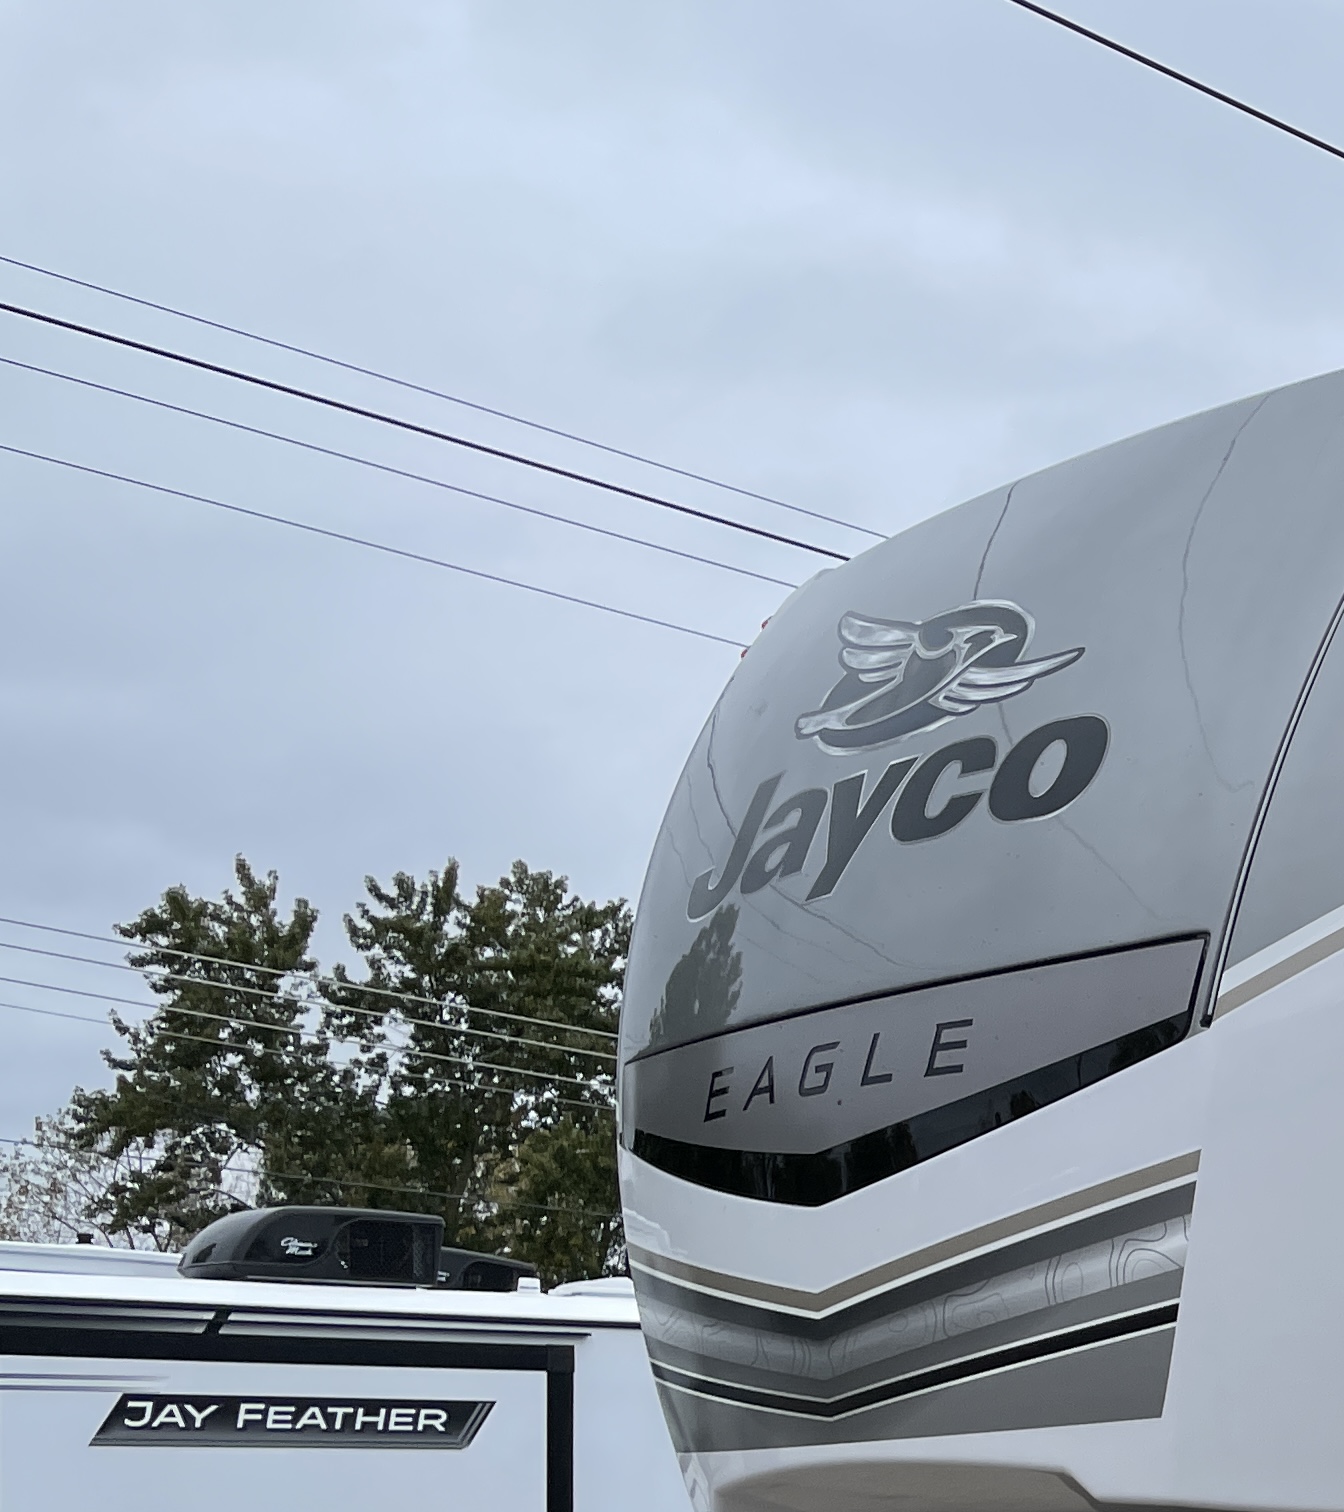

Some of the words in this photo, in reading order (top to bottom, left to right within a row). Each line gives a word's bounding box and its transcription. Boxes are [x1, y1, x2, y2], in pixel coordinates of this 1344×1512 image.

[686, 713, 1112, 923] Jayco
[703, 1018, 975, 1123] EAGLE
[123, 1401, 219, 1429] JAY
[236, 1402, 448, 1433] FEATHER
